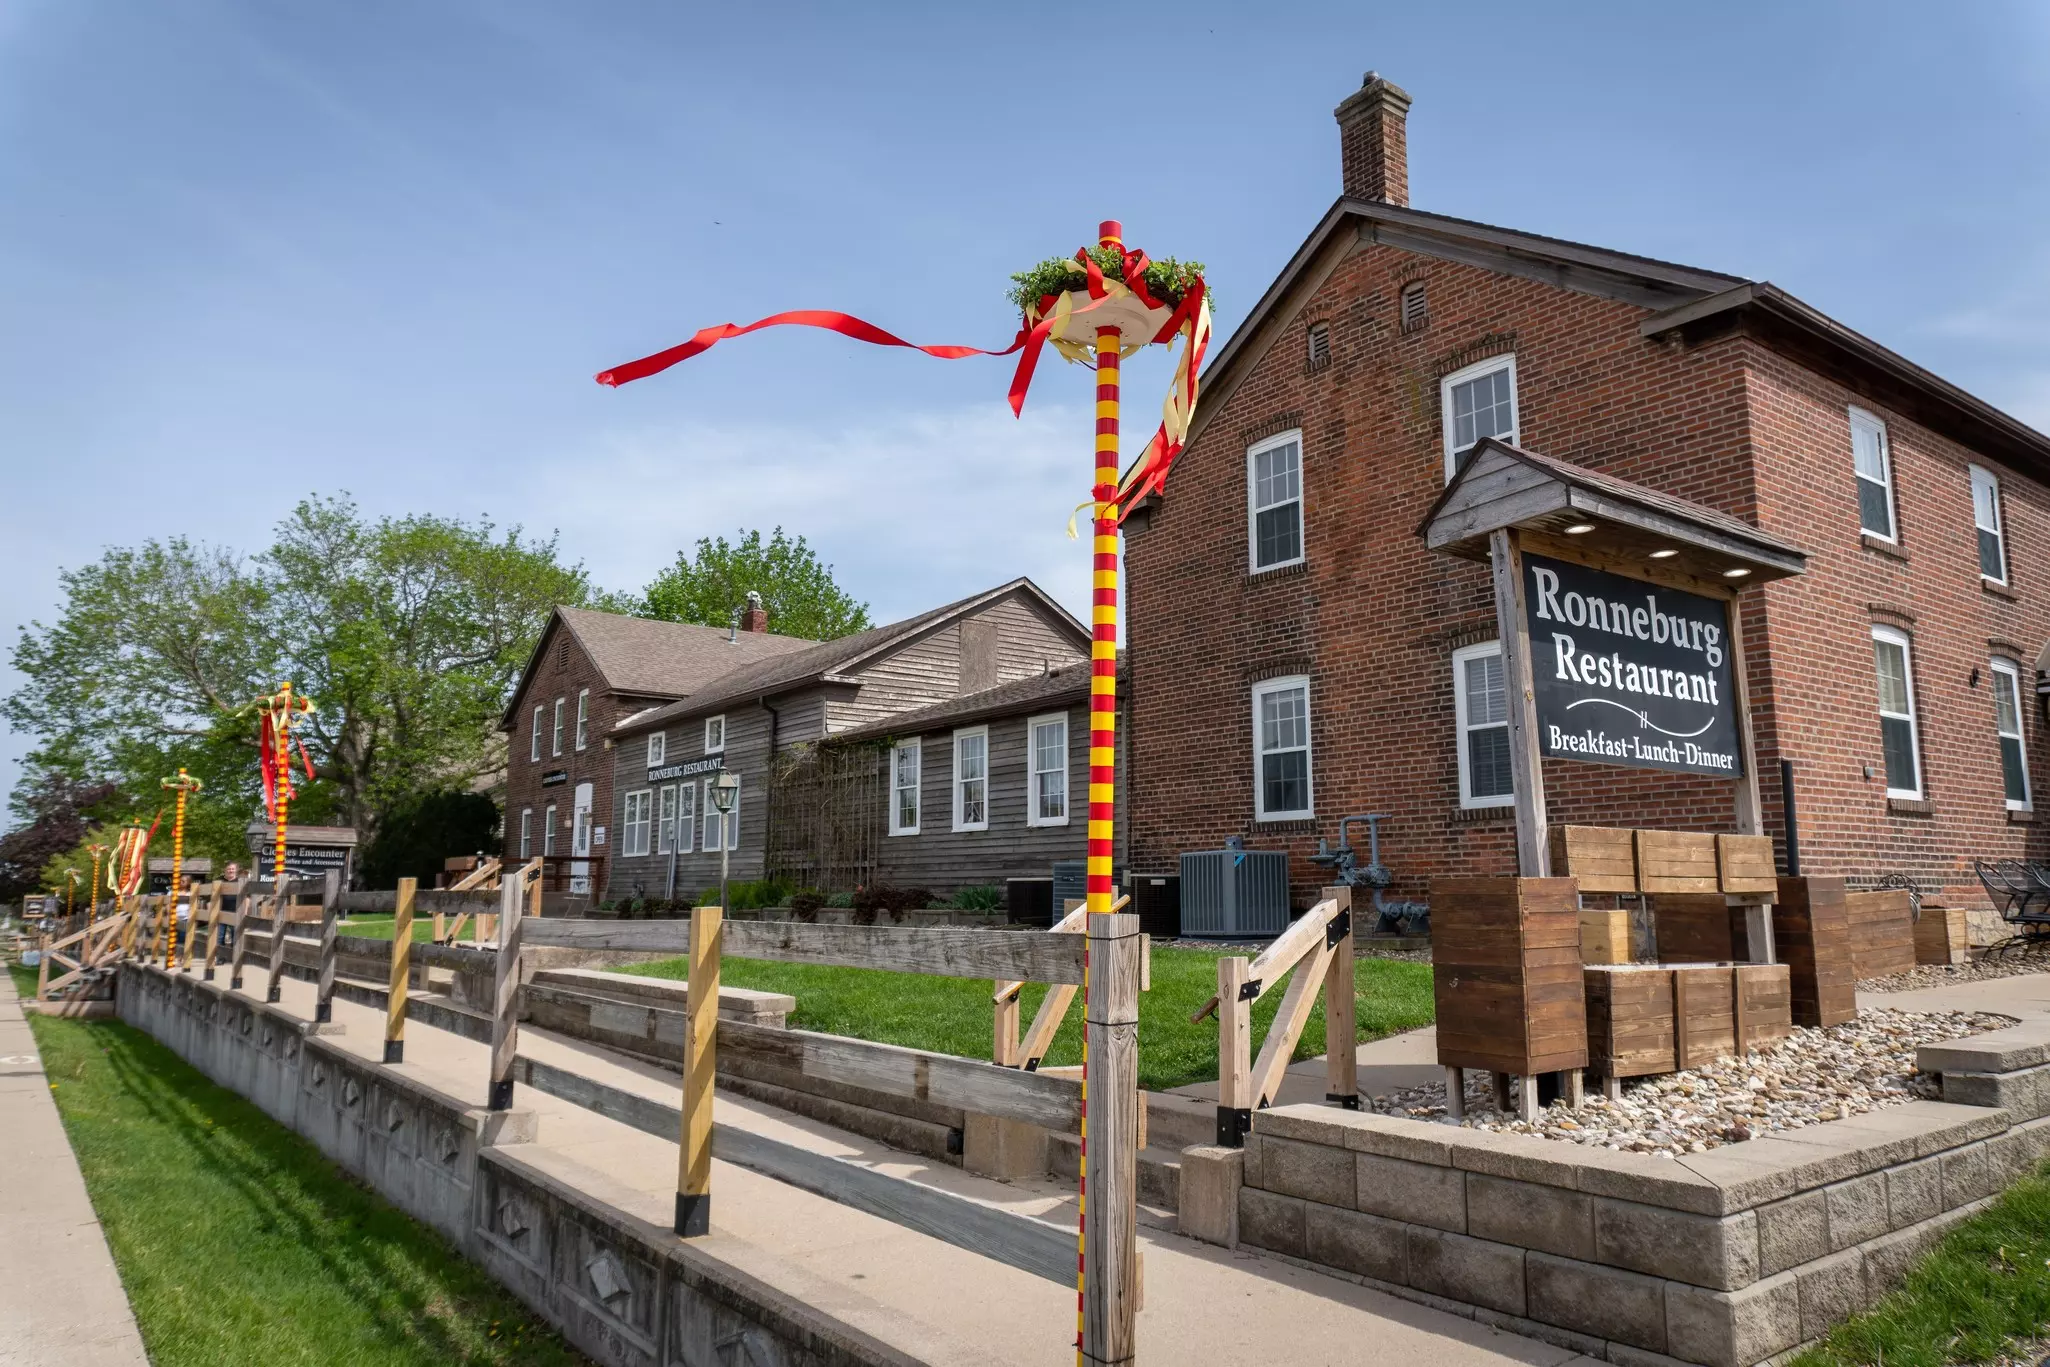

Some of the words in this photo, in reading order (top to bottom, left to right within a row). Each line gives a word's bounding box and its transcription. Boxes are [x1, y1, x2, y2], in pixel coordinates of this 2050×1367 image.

[1532, 566, 1722, 667] Ronneburg
[1552, 632, 1719, 705] Restaurant
[1549, 725, 1733, 769] Breakfast-Lunch-Dinner
[649, 766, 682, 781] RONNEBURG
[684, 758, 722, 775] RESTAURANT
[262, 846, 296, 856] Cloes
[299, 847, 344, 858] Encounter
